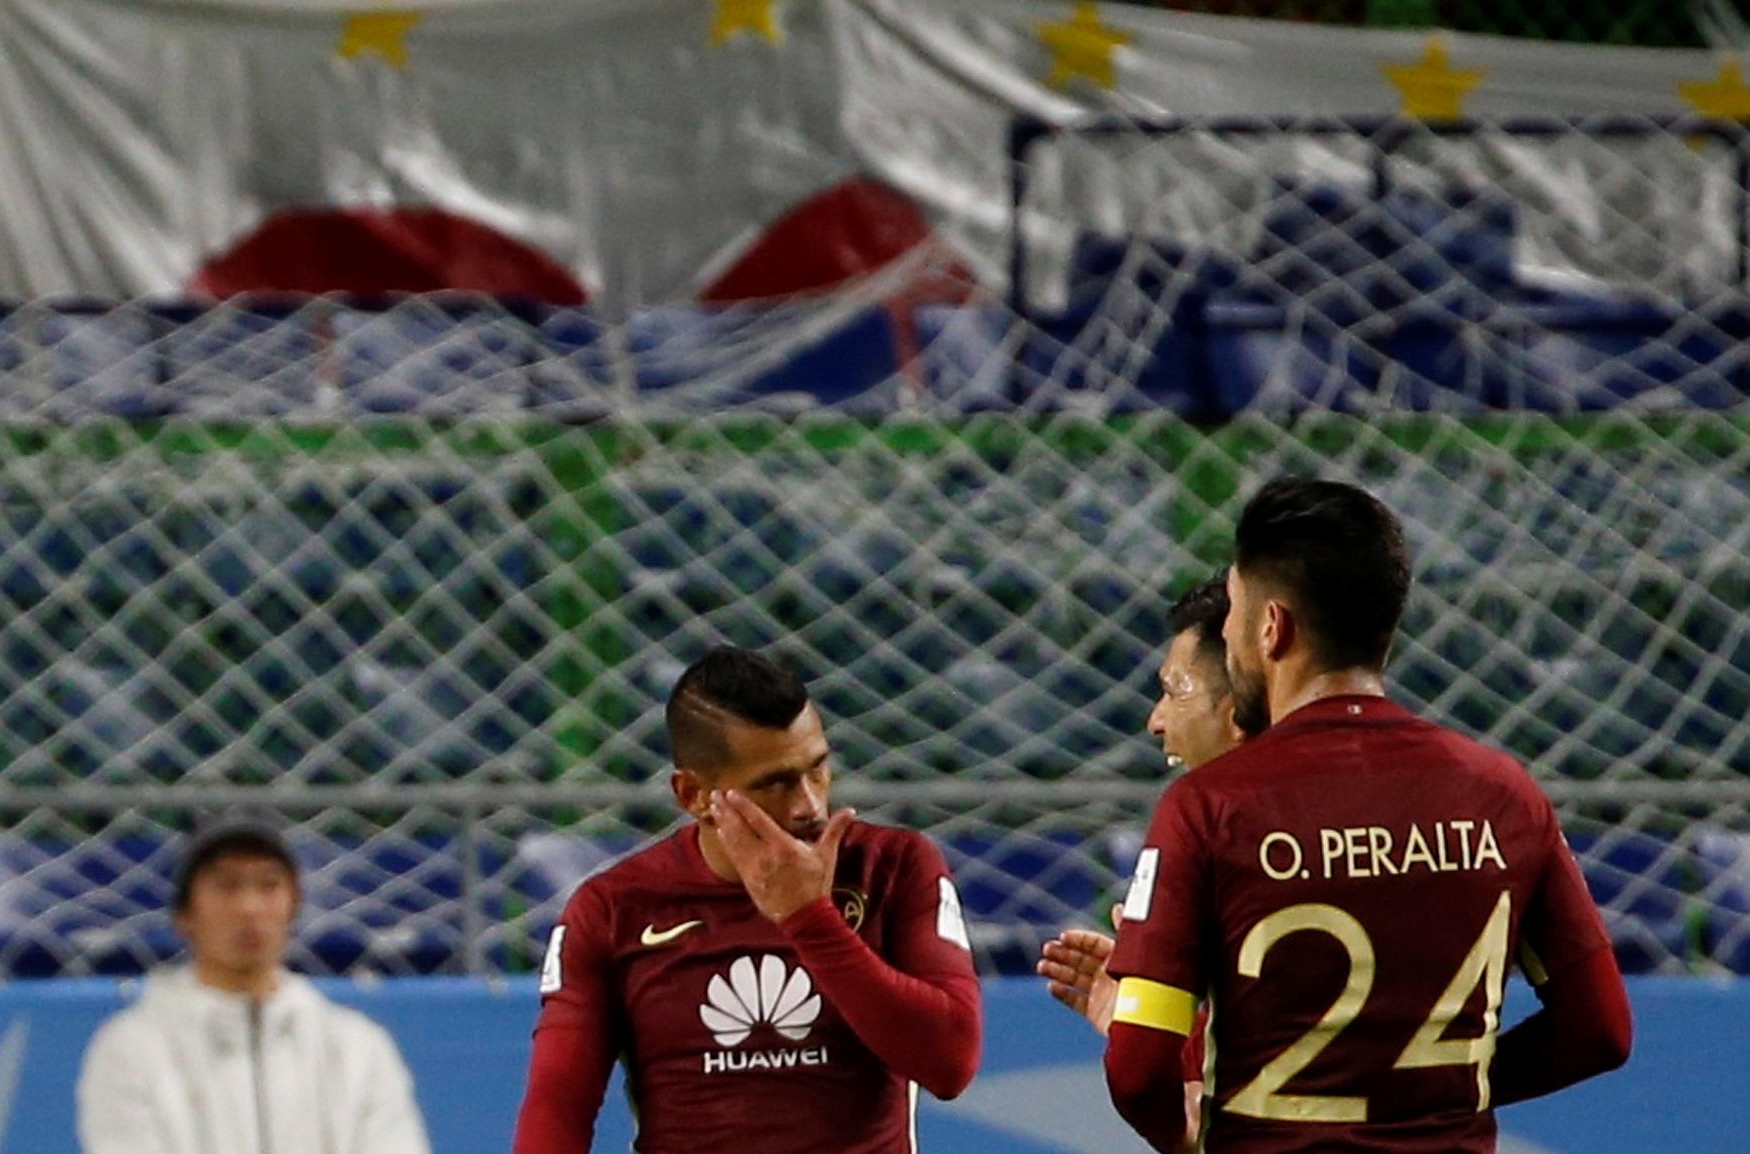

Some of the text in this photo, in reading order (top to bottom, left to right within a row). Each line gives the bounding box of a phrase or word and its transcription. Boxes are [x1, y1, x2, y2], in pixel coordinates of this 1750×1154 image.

[1259, 819, 1508, 880] O. PERALTA
[1221, 889, 1512, 1123] 24
[703, 1045, 829, 1075] HUAWEI
